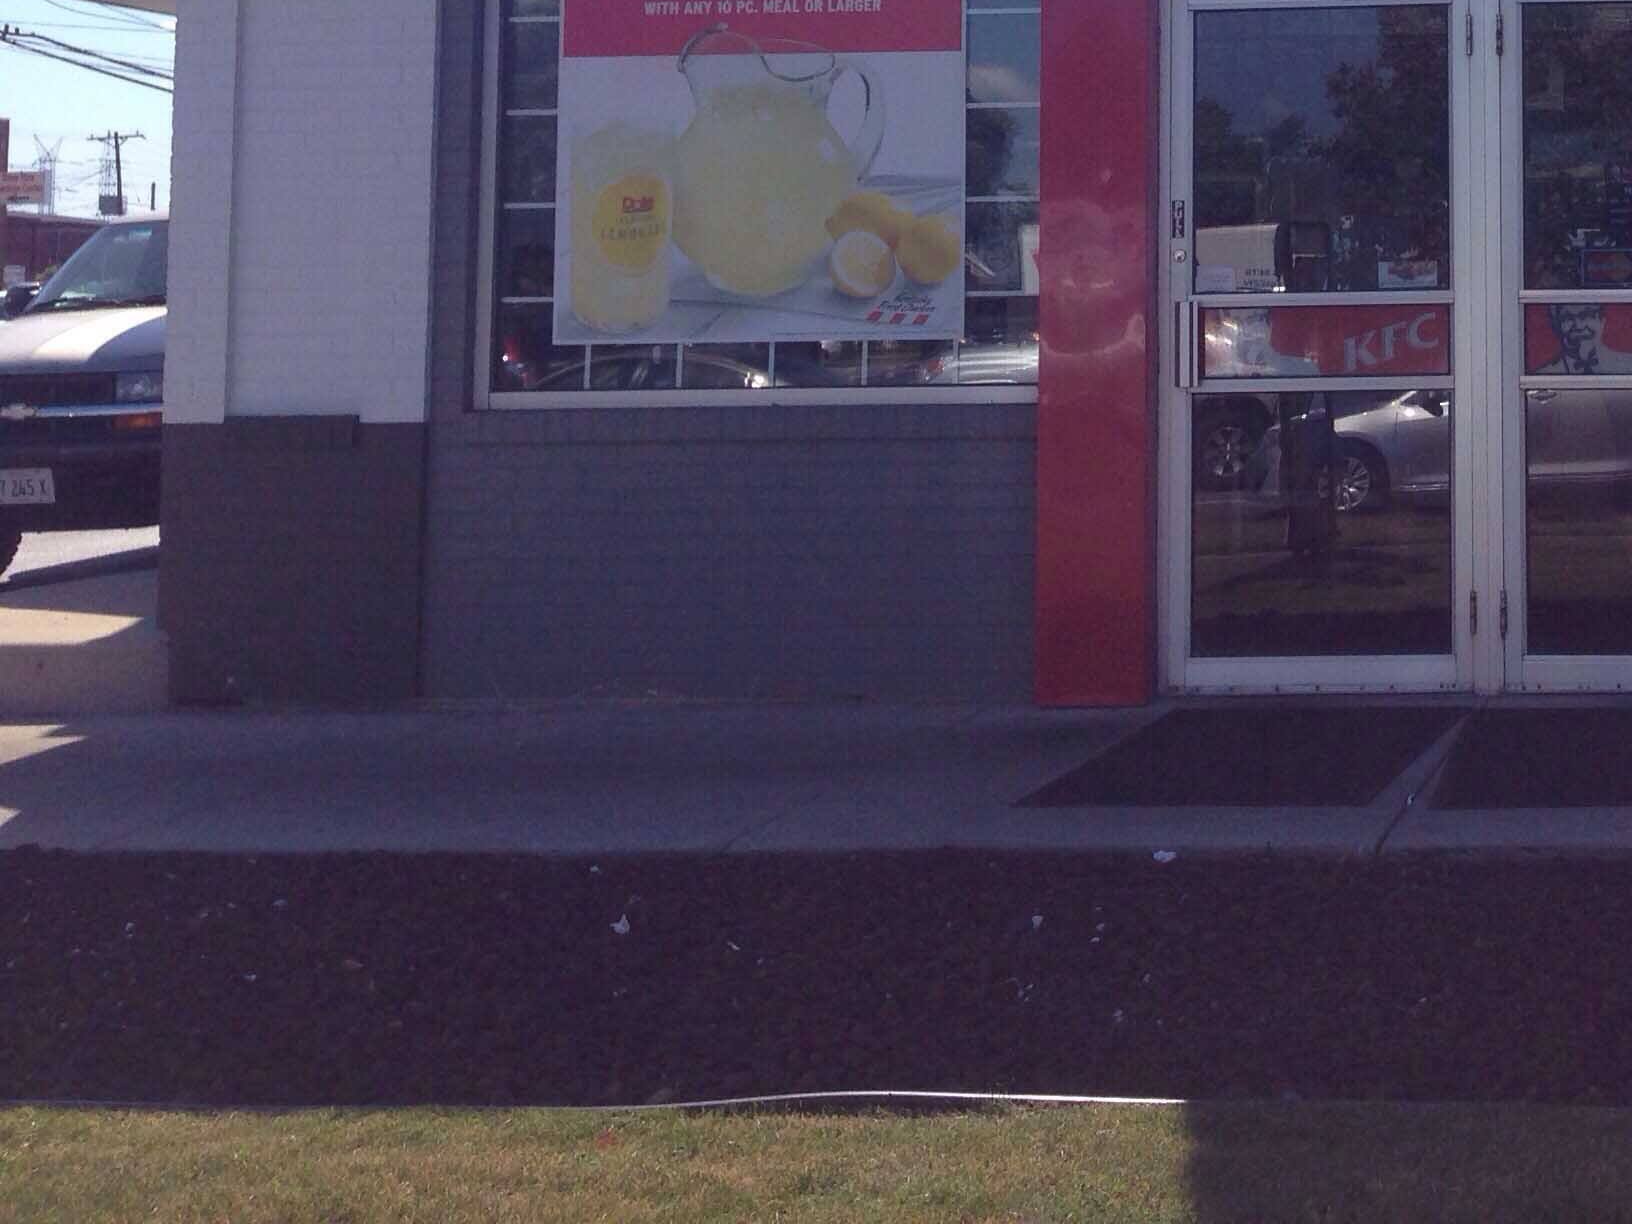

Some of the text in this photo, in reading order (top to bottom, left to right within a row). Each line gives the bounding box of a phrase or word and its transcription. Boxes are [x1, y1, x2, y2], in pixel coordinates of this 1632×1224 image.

[644, 1, 680, 16] WITH
[683, 1, 713, 15] ANY
[717, 1, 731, 14] 10
[735, 0, 758, 14] PC.
[763, 0, 800, 14] MEAL
[804, 0, 823, 13] OR
[1344, 312, 1440, 374] KFC
